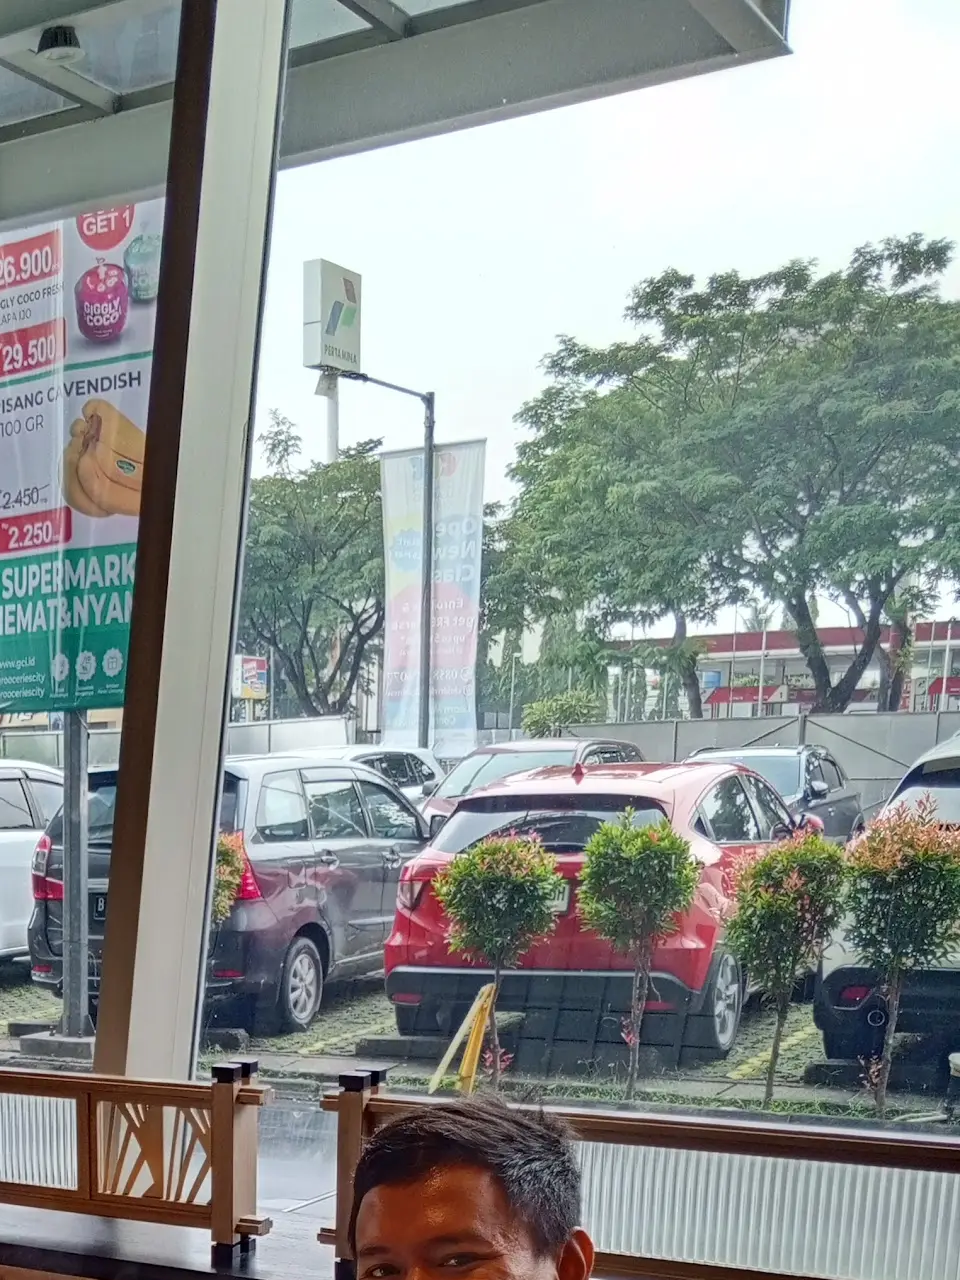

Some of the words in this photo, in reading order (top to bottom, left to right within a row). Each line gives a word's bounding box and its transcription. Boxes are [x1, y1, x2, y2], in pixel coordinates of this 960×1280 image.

[82, 210, 118, 236] GET
[122, 208, 131, 227] 1
[17, 290, 41, 305] COCO
[83, 297, 121, 316] GIGGLY
[86, 311, 121, 327] COCO
[2, 333, 56, 372] 29.500
[47, 370, 141, 403] CAVENDISH
[0, 420, 22, 438] 100
[25, 414, 44, 432] GR
[2, 486, 39, 510] 2.450
[8, 520, 52, 549] 2.250
[1, 551, 137, 600] SUPERMARK
[98, 897, 105, 911] B
